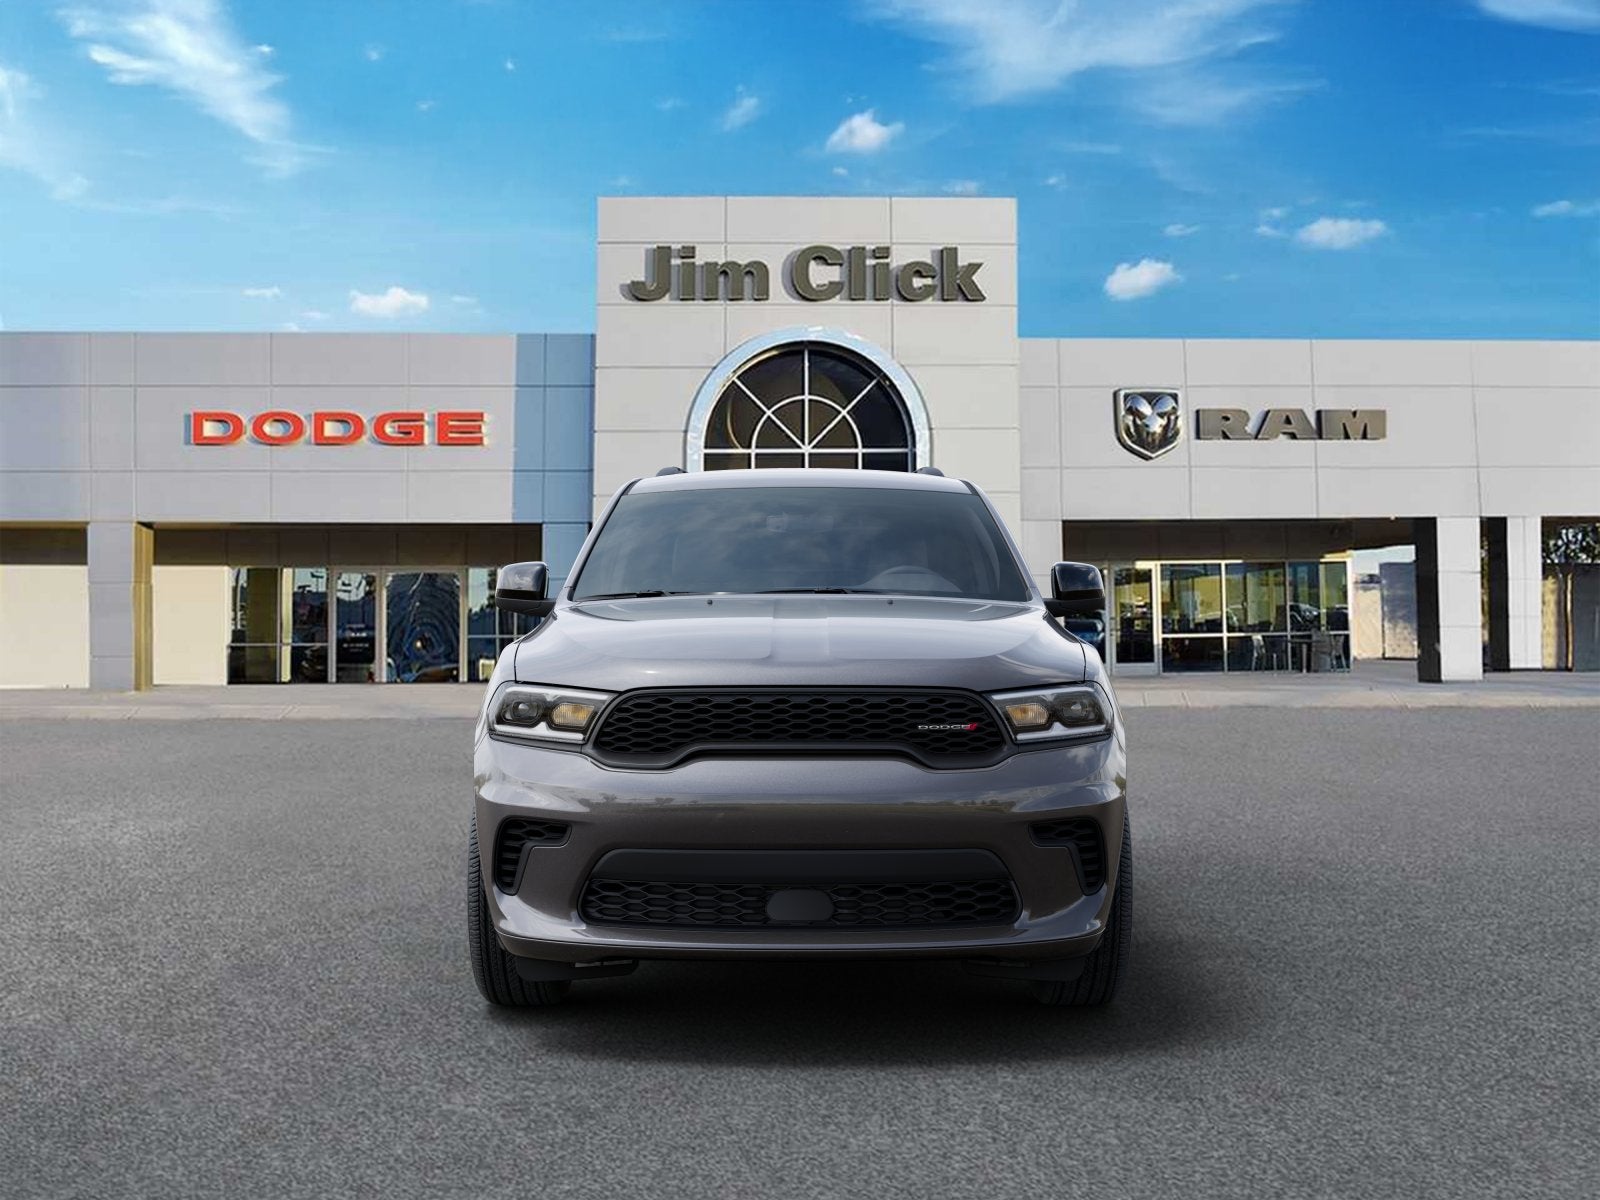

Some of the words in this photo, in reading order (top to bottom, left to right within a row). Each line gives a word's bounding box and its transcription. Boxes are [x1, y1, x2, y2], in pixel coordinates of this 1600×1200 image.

[627, 245, 770, 302] Jim
[790, 245, 987, 302] Click
[191, 410, 485, 447] DODGE
[1196, 408, 1387, 441] RAM
